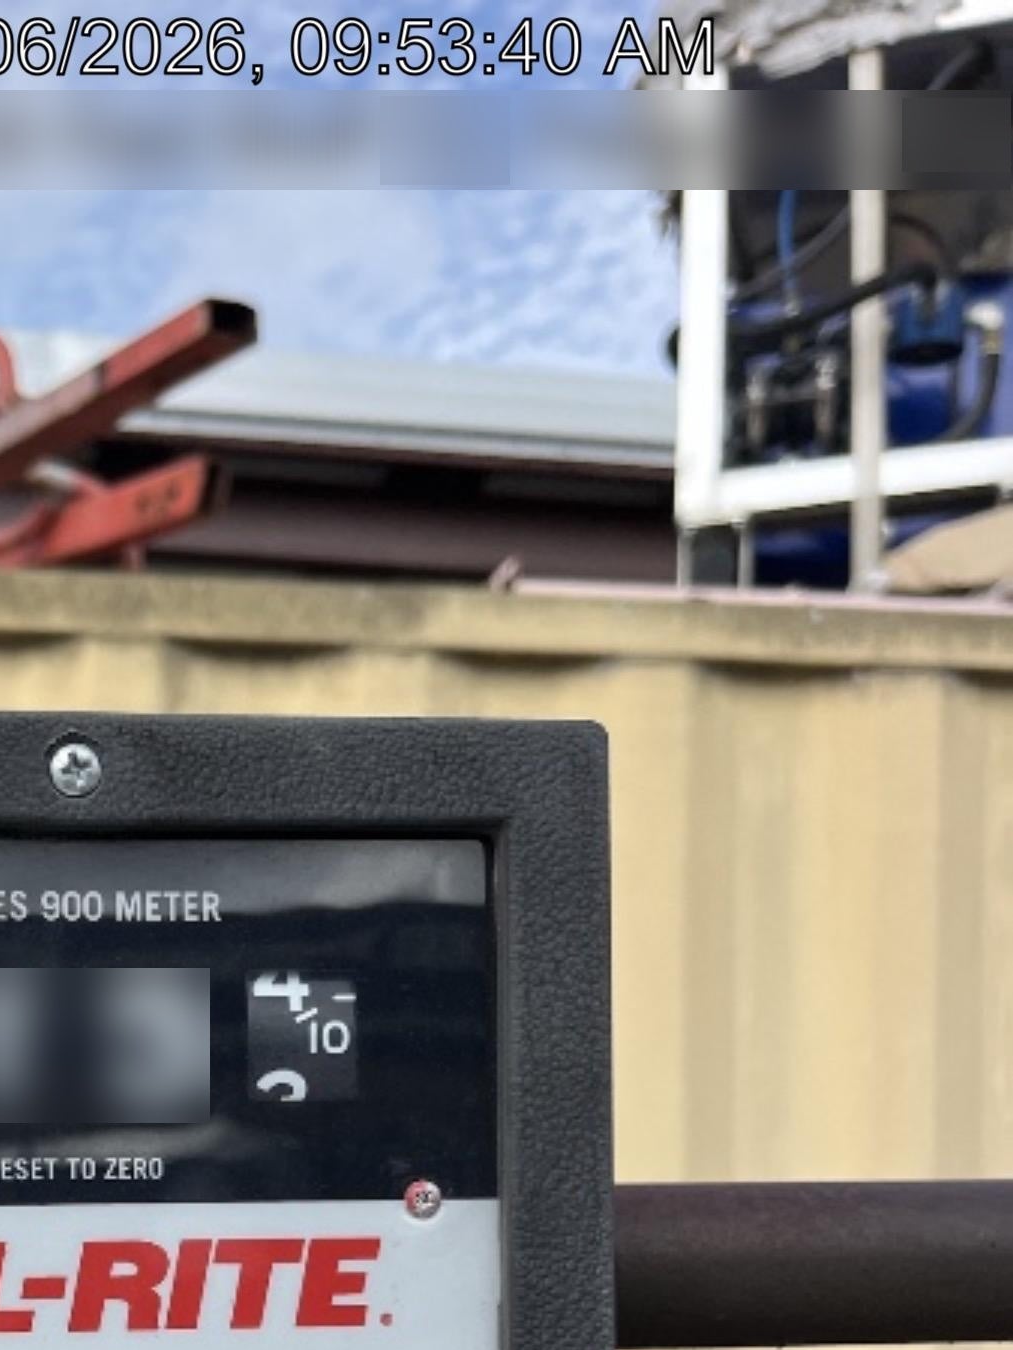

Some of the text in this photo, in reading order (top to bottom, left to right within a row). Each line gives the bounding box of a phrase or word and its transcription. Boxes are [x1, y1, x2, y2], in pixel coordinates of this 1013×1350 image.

[40, 890, 103, 922] 900
[115, 890, 222, 922] METER
[65, 1156, 97, 1181] TO
[103, 1156, 165, 1181] ZERO
